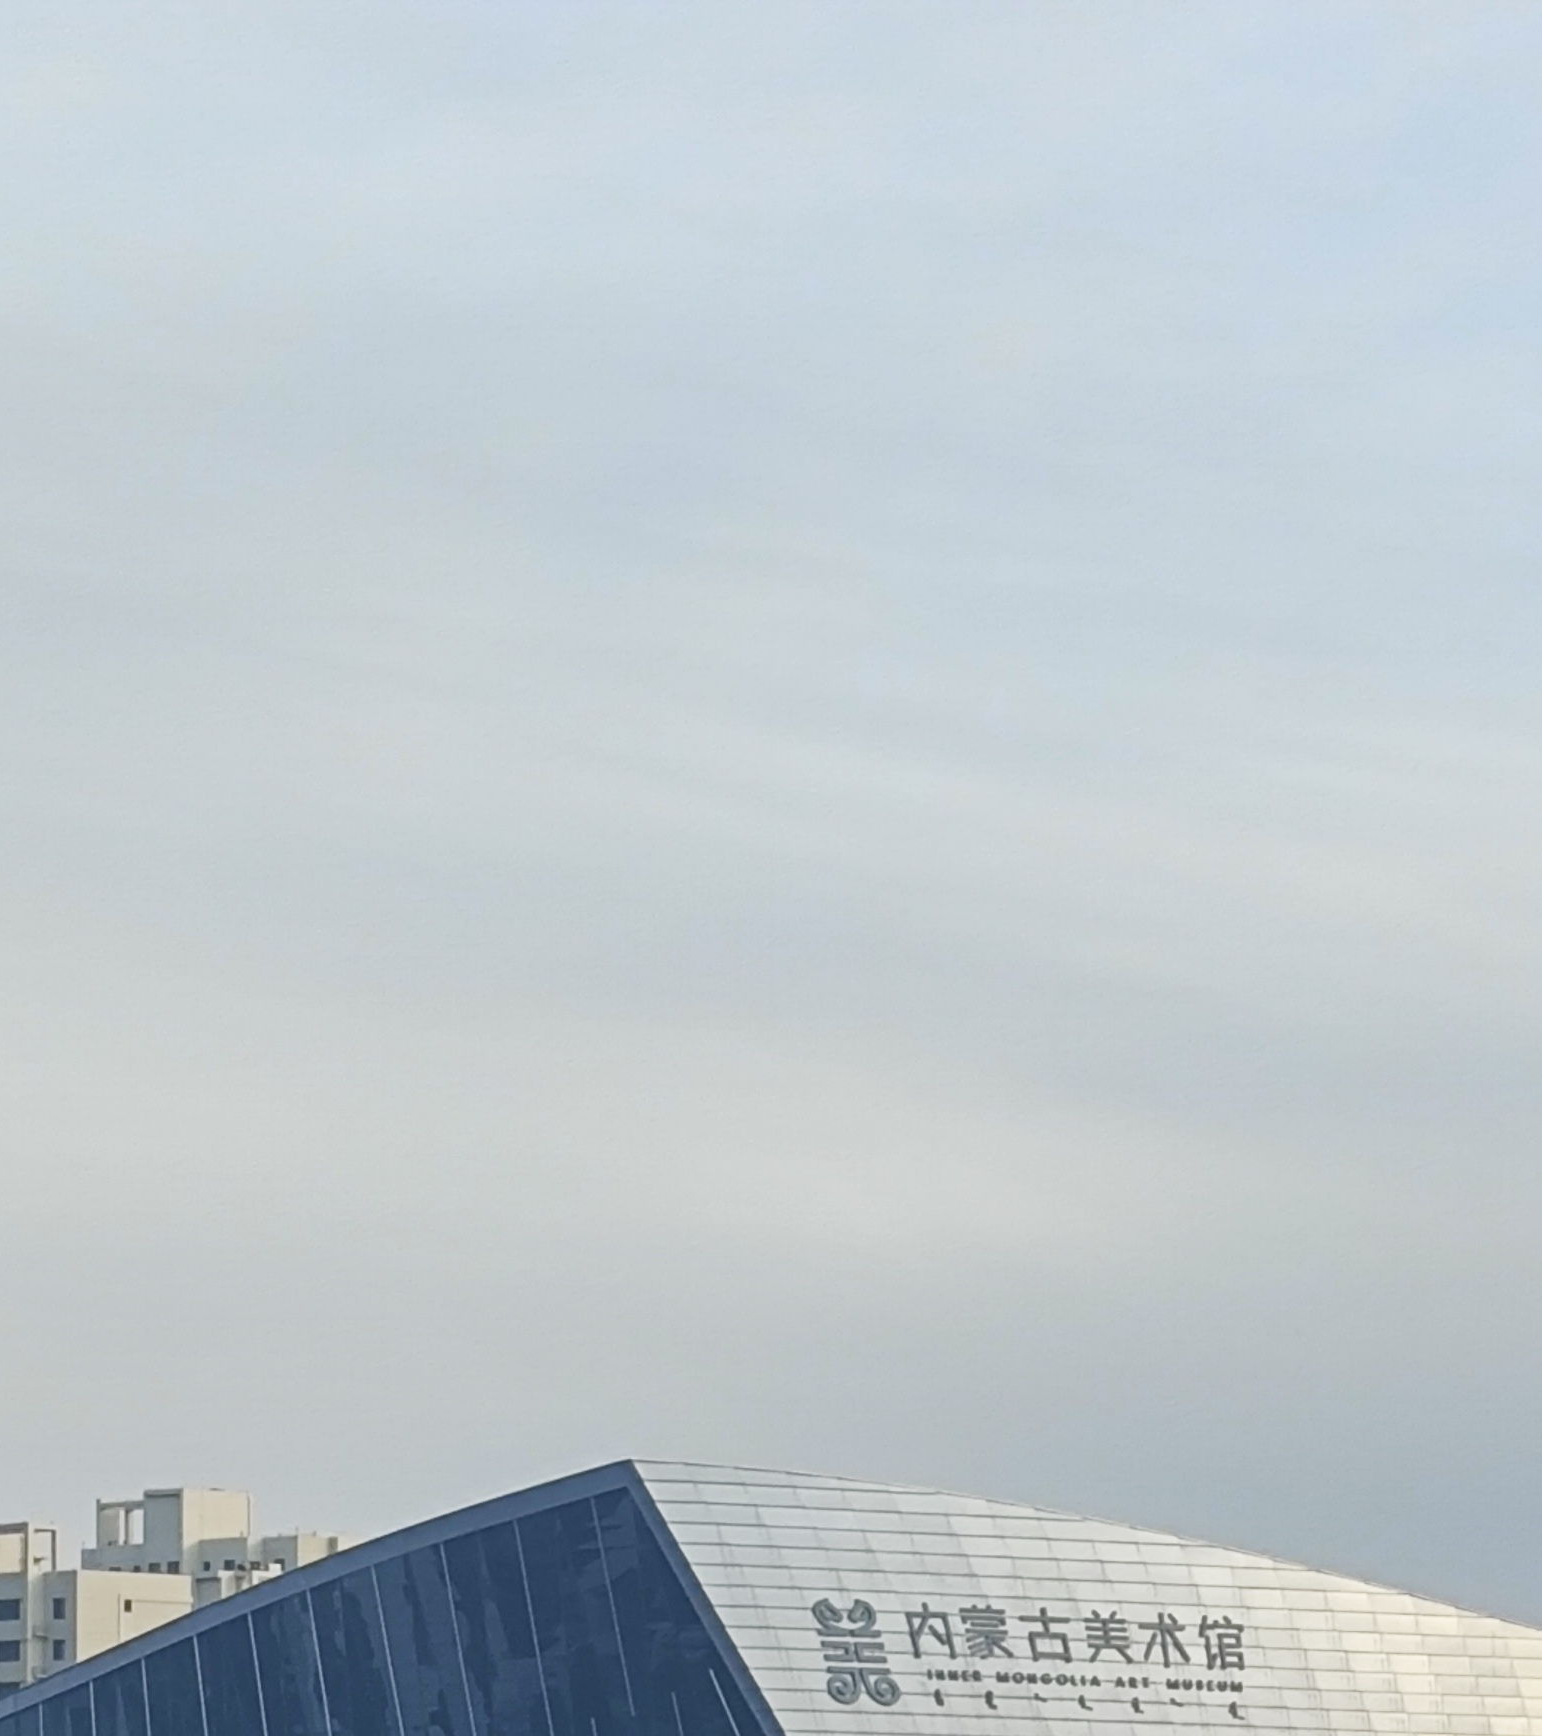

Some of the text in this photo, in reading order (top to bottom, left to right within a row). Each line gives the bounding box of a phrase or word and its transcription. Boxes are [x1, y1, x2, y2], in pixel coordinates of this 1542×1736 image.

[904, 1601, 1246, 1671] 内蒙古美术馆
[926, 1668, 1245, 1694] INNER MONGOLIA ART MUSEUM
